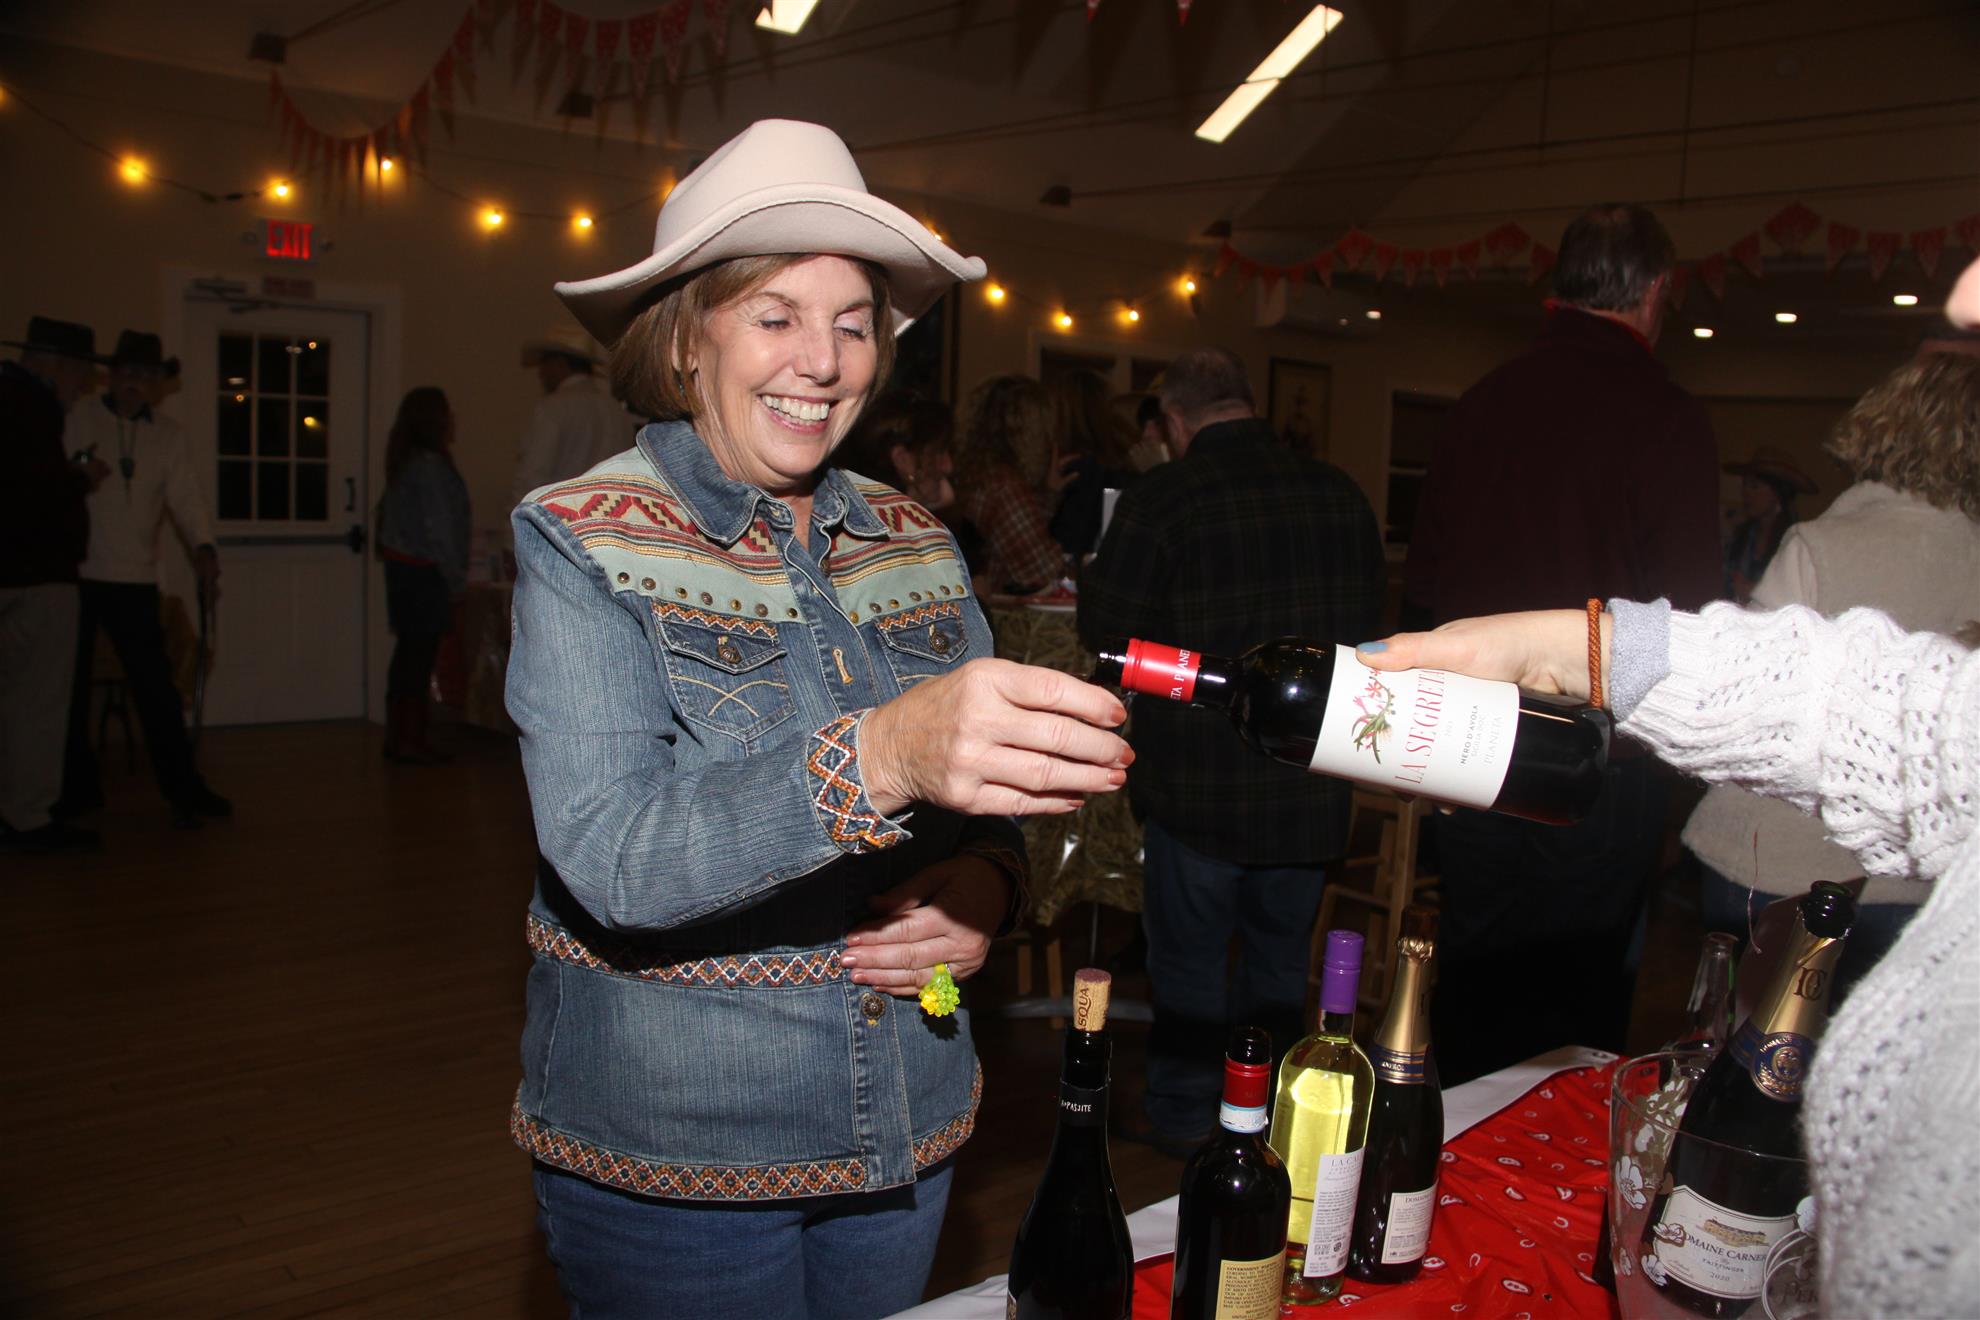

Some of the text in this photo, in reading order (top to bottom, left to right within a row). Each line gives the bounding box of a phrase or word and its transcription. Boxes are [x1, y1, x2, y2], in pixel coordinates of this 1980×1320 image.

[267, 219, 313, 260] EXIT
[1460, 741, 1471, 765] NERO
[1484, 717, 1502, 764] PLANETA
[1394, 764, 1427, 784] LA
[1078, 987, 1092, 1029] SQUA
[1685, 1231, 1766, 1263] OMAINE CARNER
